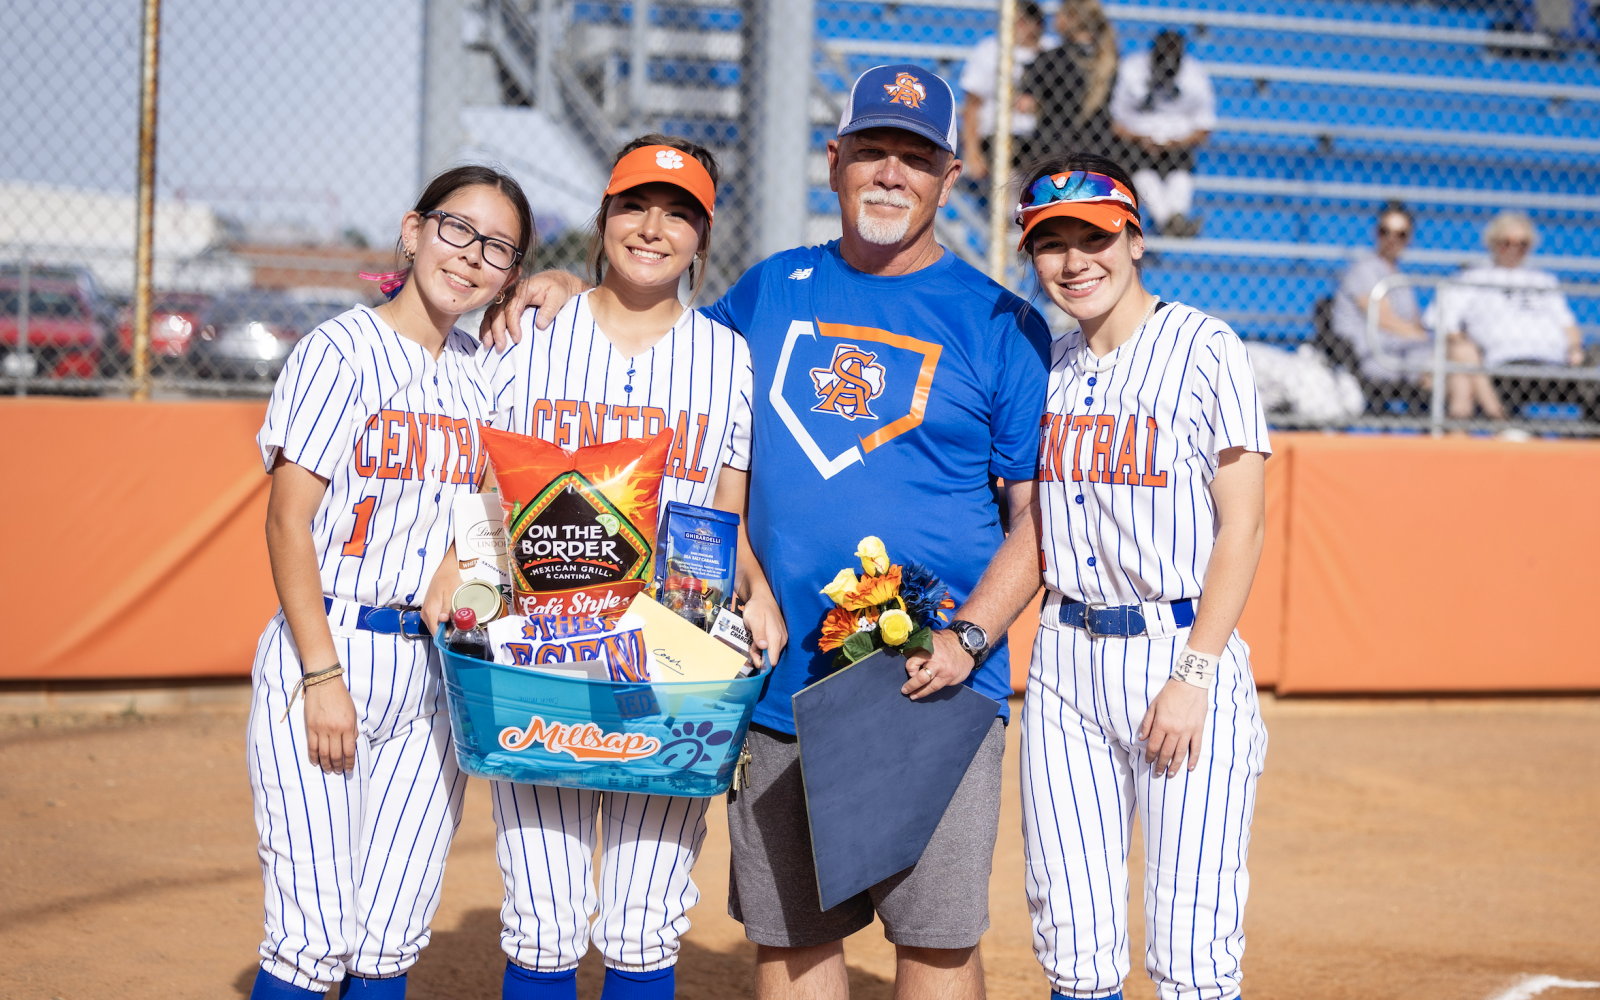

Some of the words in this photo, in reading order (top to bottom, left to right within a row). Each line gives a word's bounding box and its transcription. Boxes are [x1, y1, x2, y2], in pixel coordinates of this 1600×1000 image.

[355, 409, 490, 485] CENTRA
[1039, 412, 1168, 488] ENTRAL
[341, 495, 378, 558] 1
[476, 526, 503, 537] Lindt
[528, 525, 557, 539] ON
[562, 524, 603, 539] THE
[685, 532, 721, 544] GHIRARDELLI
[521, 539, 621, 563] BORDER
[462, 560, 477, 569] WHIT
[532, 564, 577, 576] MEXICAN
[580, 565, 609, 577] GRILL
[519, 595, 563, 616] Café
[567, 589, 620, 618] Style
[730, 624, 745, 635] WALL
[652, 648, 682, 670] Coach
[1195, 658, 1209, 680] For
[501, 718, 659, 760] Millsap
